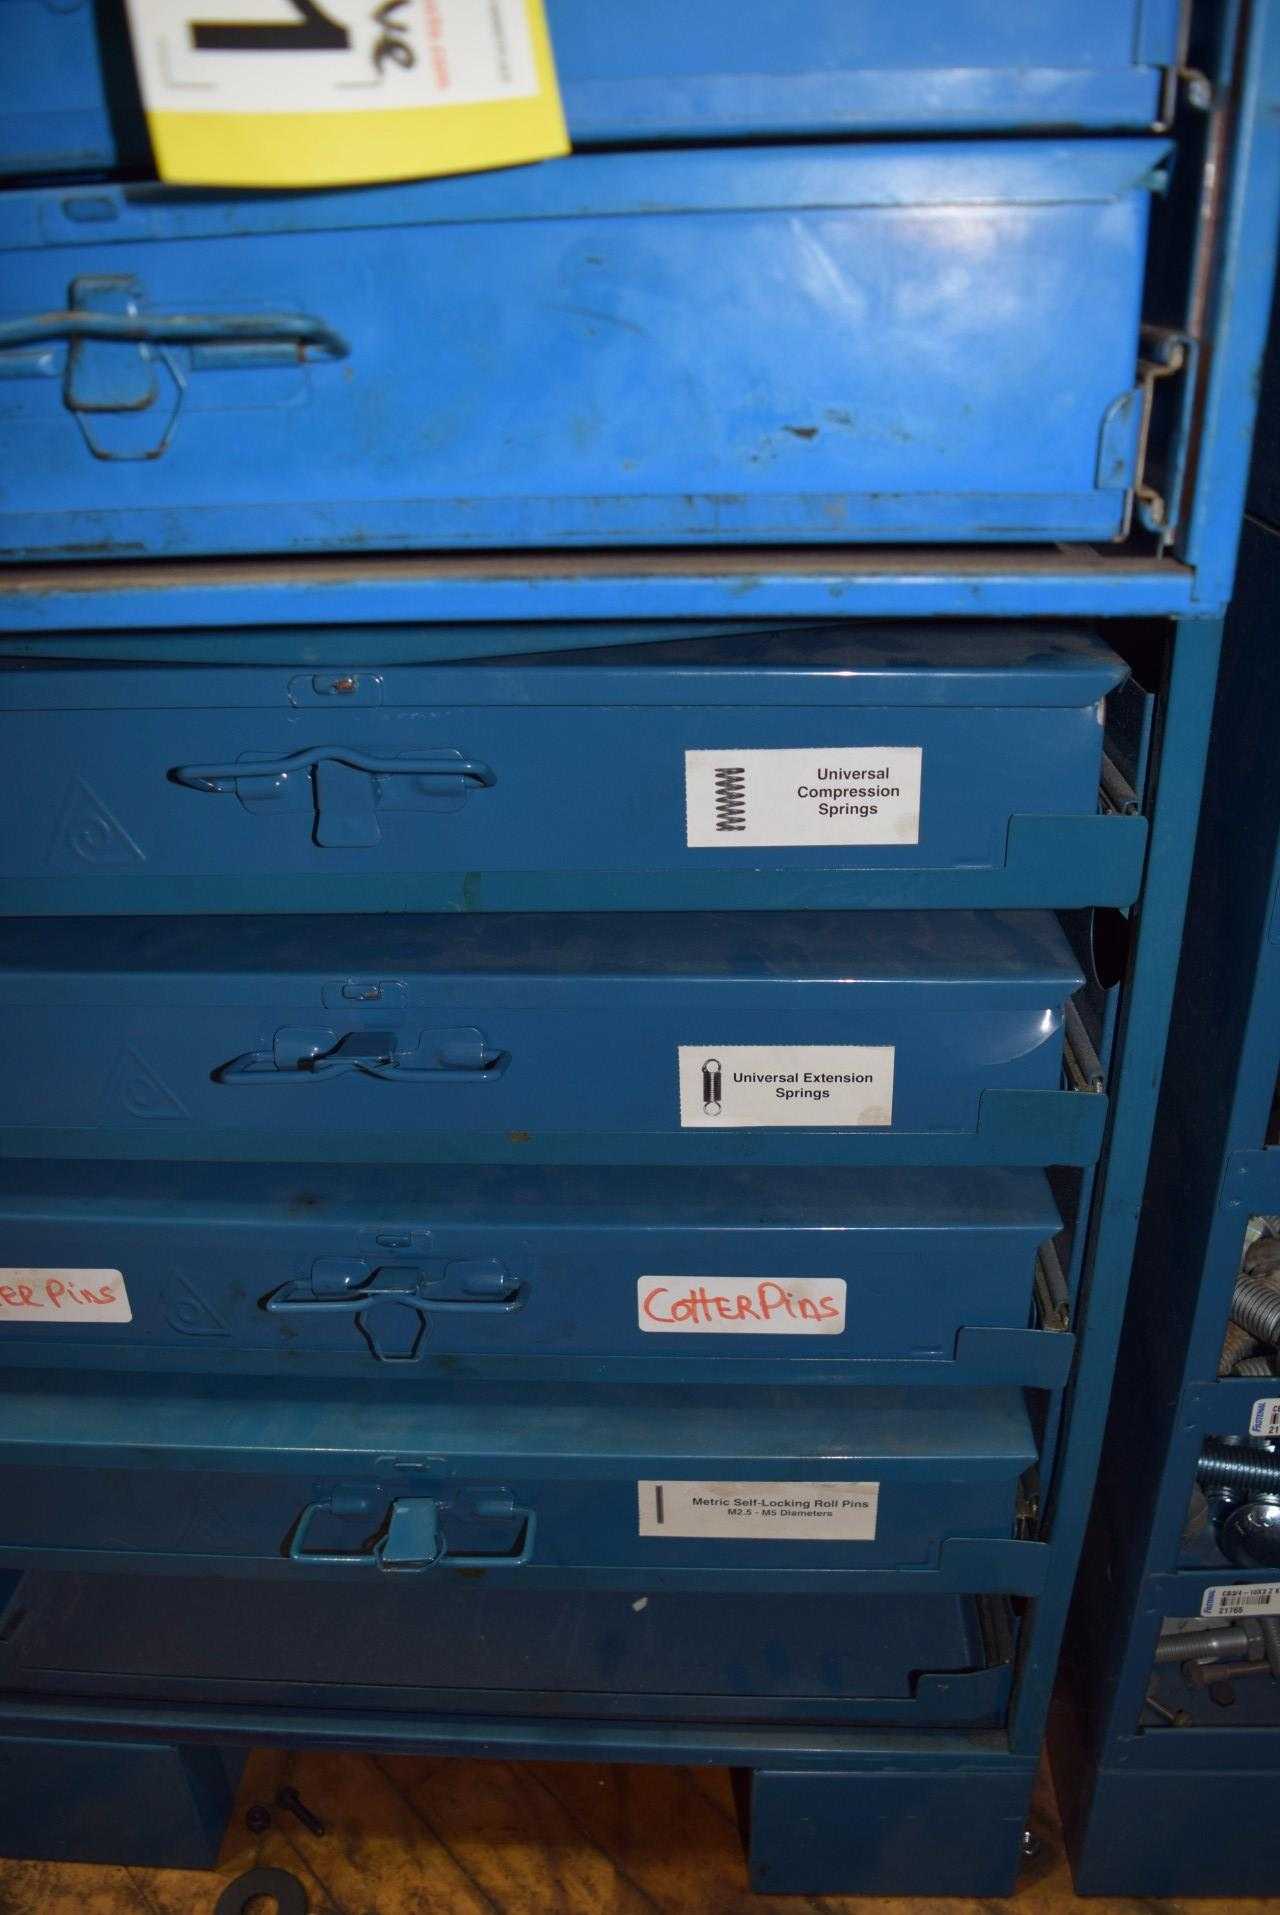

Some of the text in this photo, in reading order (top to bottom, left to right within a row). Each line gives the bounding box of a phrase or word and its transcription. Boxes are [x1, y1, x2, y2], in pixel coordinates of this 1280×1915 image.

[817, 767, 889, 780] Universal
[797, 786, 900, 801] Compression
[818, 803, 878, 818] Springs
[733, 1072, 873, 1083] Universal Extension
[775, 1088, 830, 1100] Springs
[692, 1497, 870, 1509] Metric Self-Locking Roll Pins
[780, 1509, 833, 1517] Diameters
